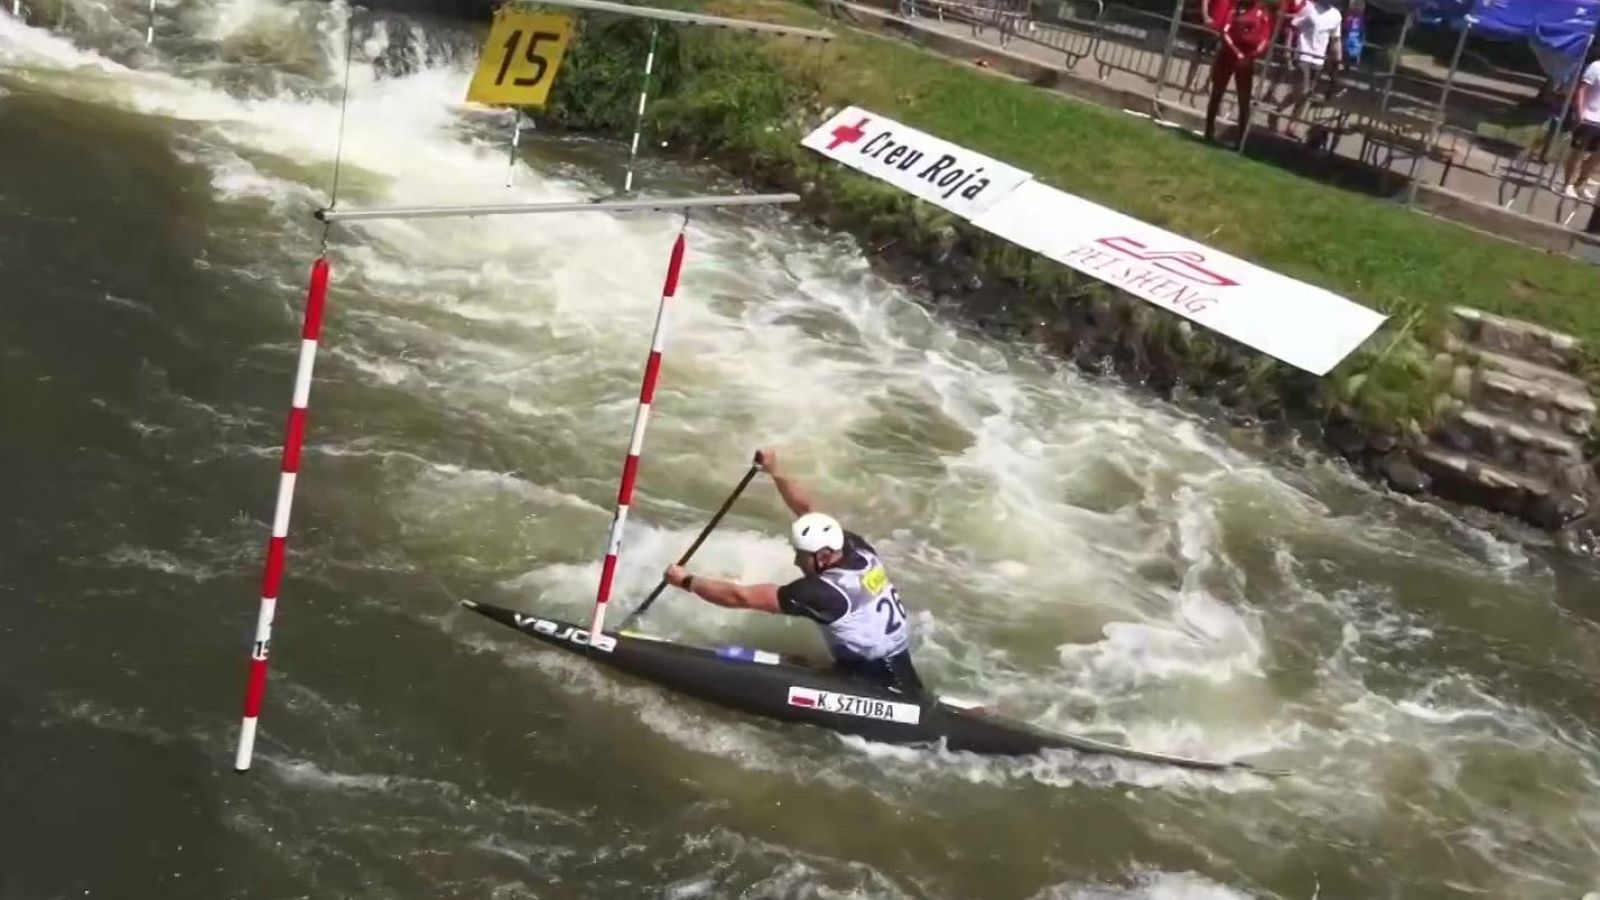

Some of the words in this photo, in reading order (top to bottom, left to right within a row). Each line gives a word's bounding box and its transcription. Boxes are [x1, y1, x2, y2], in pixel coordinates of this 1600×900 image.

[494, 30, 560, 86] 15
[860, 131, 924, 171] Creu
[916, 153, 991, 200] Roja
[817, 693, 832, 709] K.
[836, 696, 894, 719] SZTUBA
